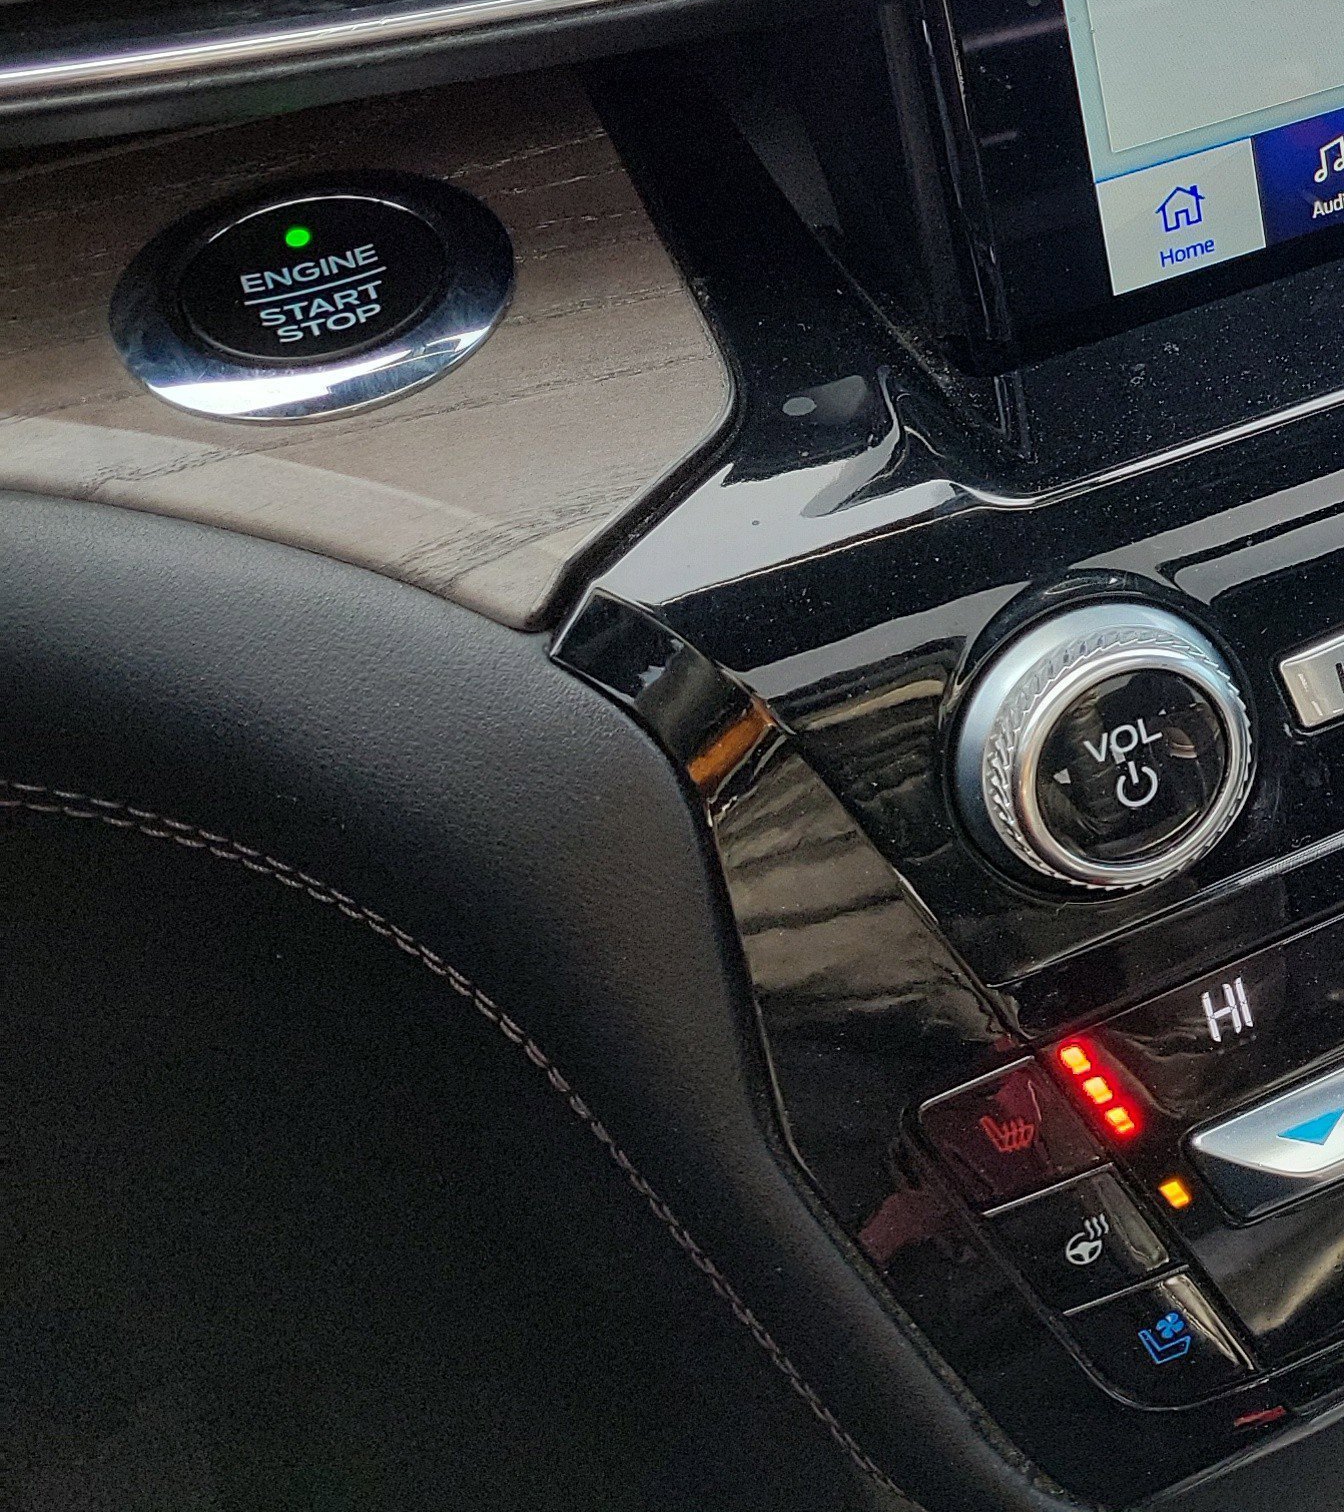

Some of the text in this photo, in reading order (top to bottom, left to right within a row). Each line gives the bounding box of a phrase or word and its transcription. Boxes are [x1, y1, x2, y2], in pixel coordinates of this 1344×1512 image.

[240, 243, 379, 294] ENGINE
[1159, 239, 1215, 268] Home
[260, 280, 382, 326] START
[277, 303, 382, 343] STOP
[1083, 718, 1163, 762] VOL
[1201, 977, 1254, 1043] HI
